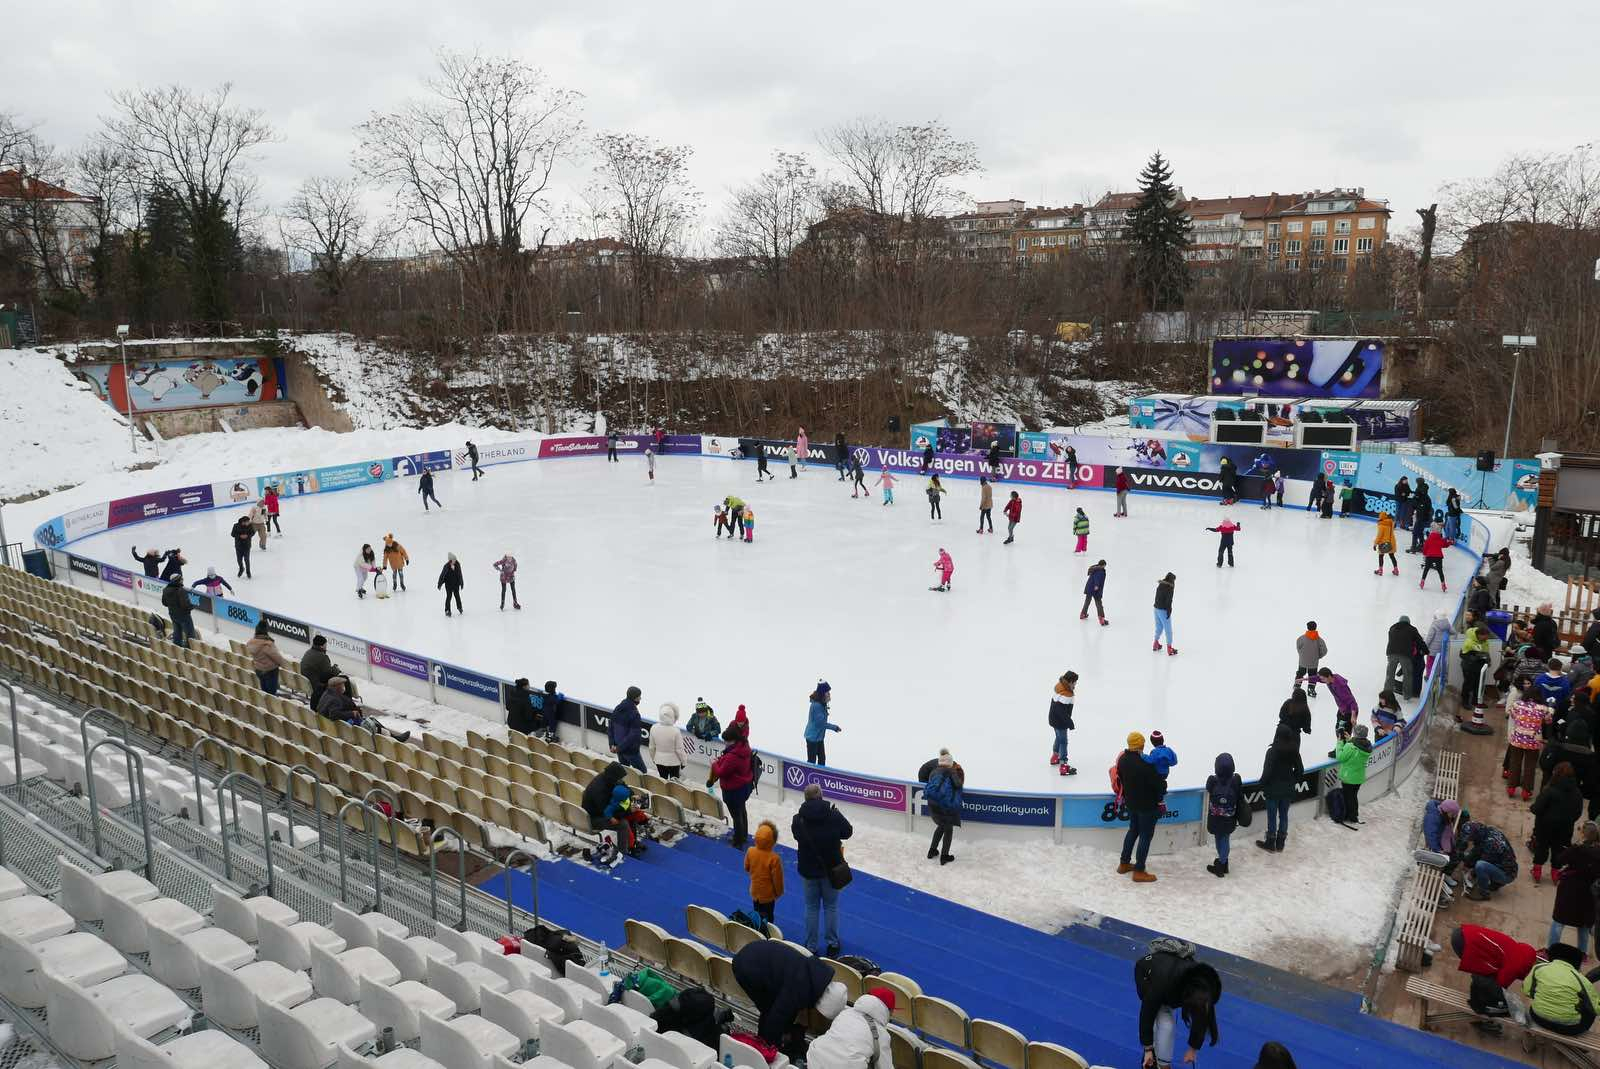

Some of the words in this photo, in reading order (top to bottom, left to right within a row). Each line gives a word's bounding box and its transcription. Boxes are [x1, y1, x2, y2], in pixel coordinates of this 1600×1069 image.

[480, 447, 525, 460] THERLAND
[1017, 462, 1038, 477] to
[72, 559, 97, 574] VIVACOM
[266, 618, 307, 638] VIVACOM
[327, 638, 367, 656] UTHERLAND
[824, 778, 882, 800] Volkswagen
[883, 789, 897, 800] ID.
